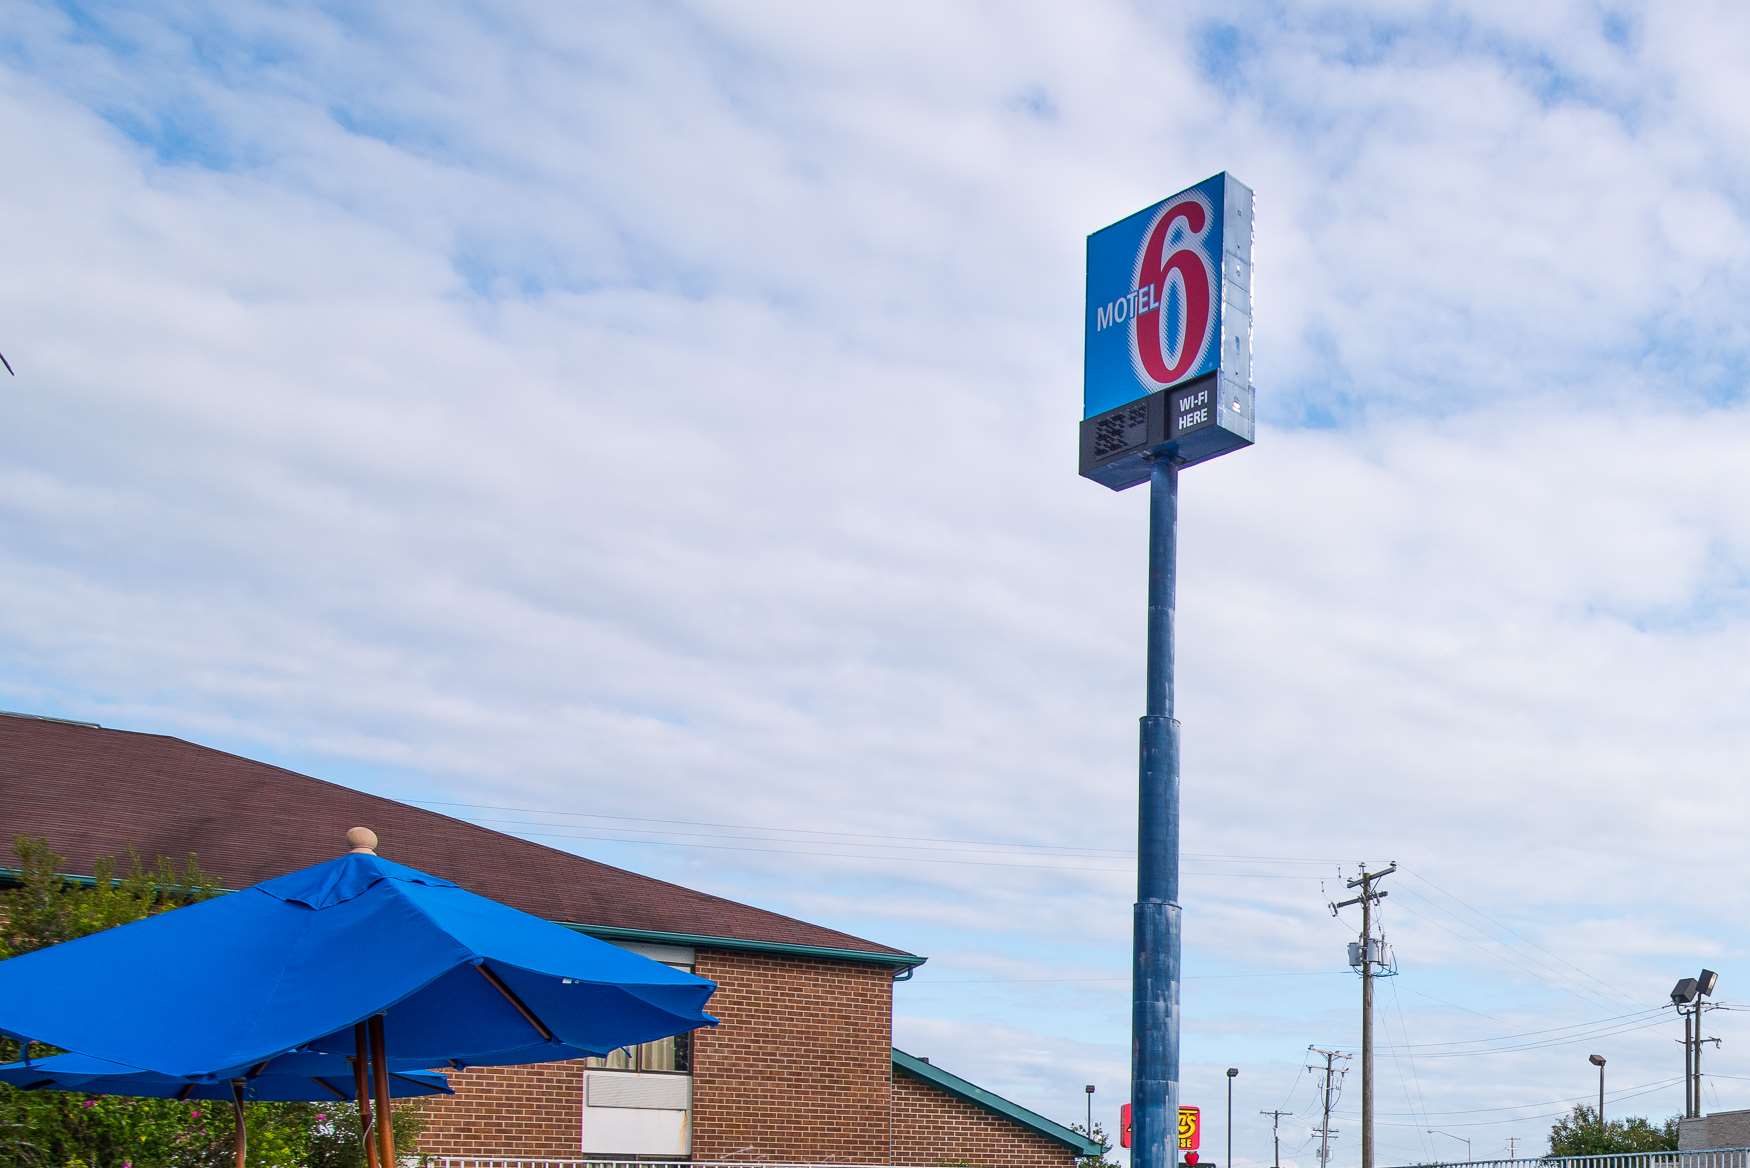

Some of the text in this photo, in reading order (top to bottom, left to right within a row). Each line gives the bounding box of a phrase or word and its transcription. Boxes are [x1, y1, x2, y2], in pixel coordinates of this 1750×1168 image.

[1097, 200, 1210, 384] MOTEL 6
[1178, 389, 1208, 413] WI-FI
[1178, 407, 1209, 431] HERE
